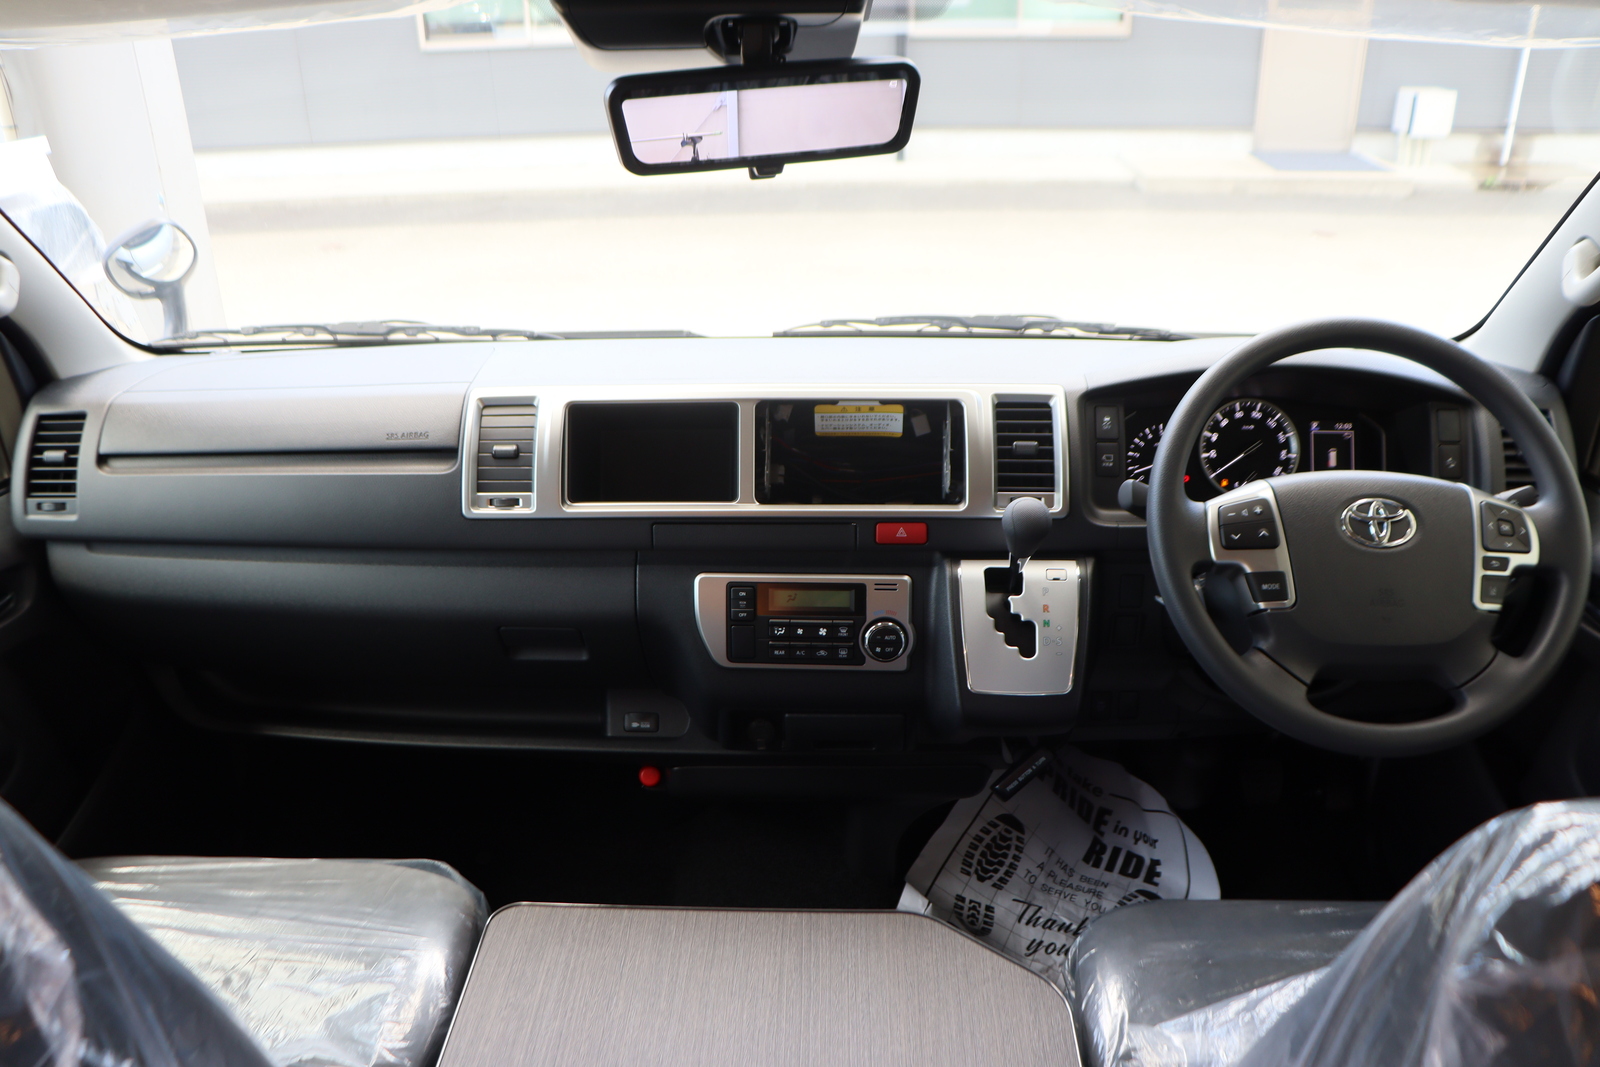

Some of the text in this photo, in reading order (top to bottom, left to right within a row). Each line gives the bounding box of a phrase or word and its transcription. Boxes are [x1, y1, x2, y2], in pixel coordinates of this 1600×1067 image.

[385, 431, 430, 440] SRS AIRBAG
[1042, 587, 1050, 596] P
[1043, 604, 1050, 613] R
[1043, 619, 1050, 628] N
[1017, 768, 1033, 782] BUTTON
[1035, 756, 1047, 767] TURN
[1067, 768, 1104, 797] take
[1112, 820, 1129, 838] in
[1133, 829, 1160, 849] your
[1044, 846, 1110, 889] IT HAS BEEN
[1082, 834, 1162, 887] RIDE
[1023, 869, 1107, 914] TO SERVE YOU
[1036, 861, 1105, 898] A PLEASURE
[1012, 898, 1090, 936] Thank
[1025, 938, 1072, 957] you
